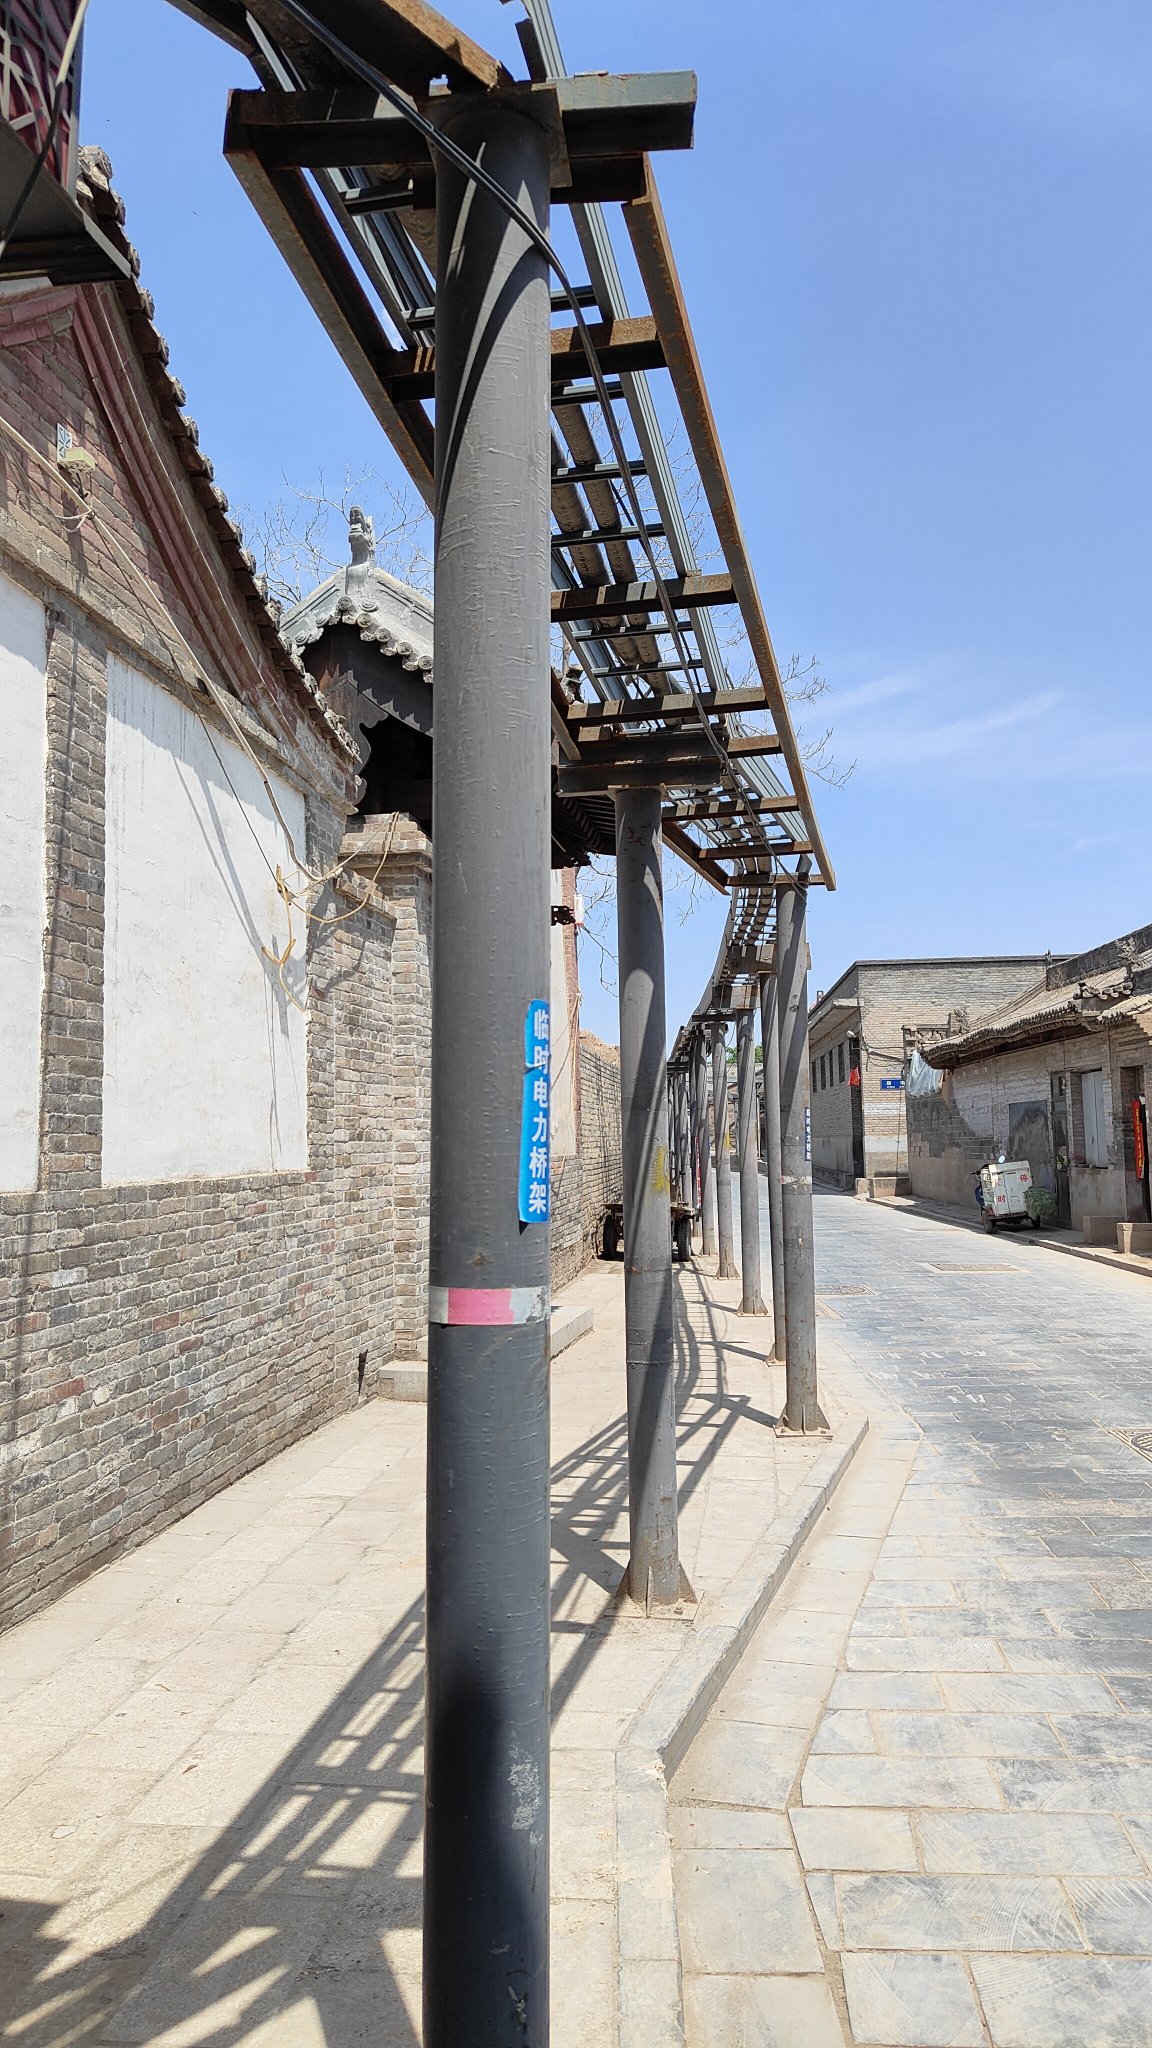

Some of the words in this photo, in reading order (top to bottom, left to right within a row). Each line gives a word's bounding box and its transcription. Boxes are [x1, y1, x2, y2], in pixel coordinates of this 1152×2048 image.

[528, 1008, 550, 1215] 临时电力桥架
